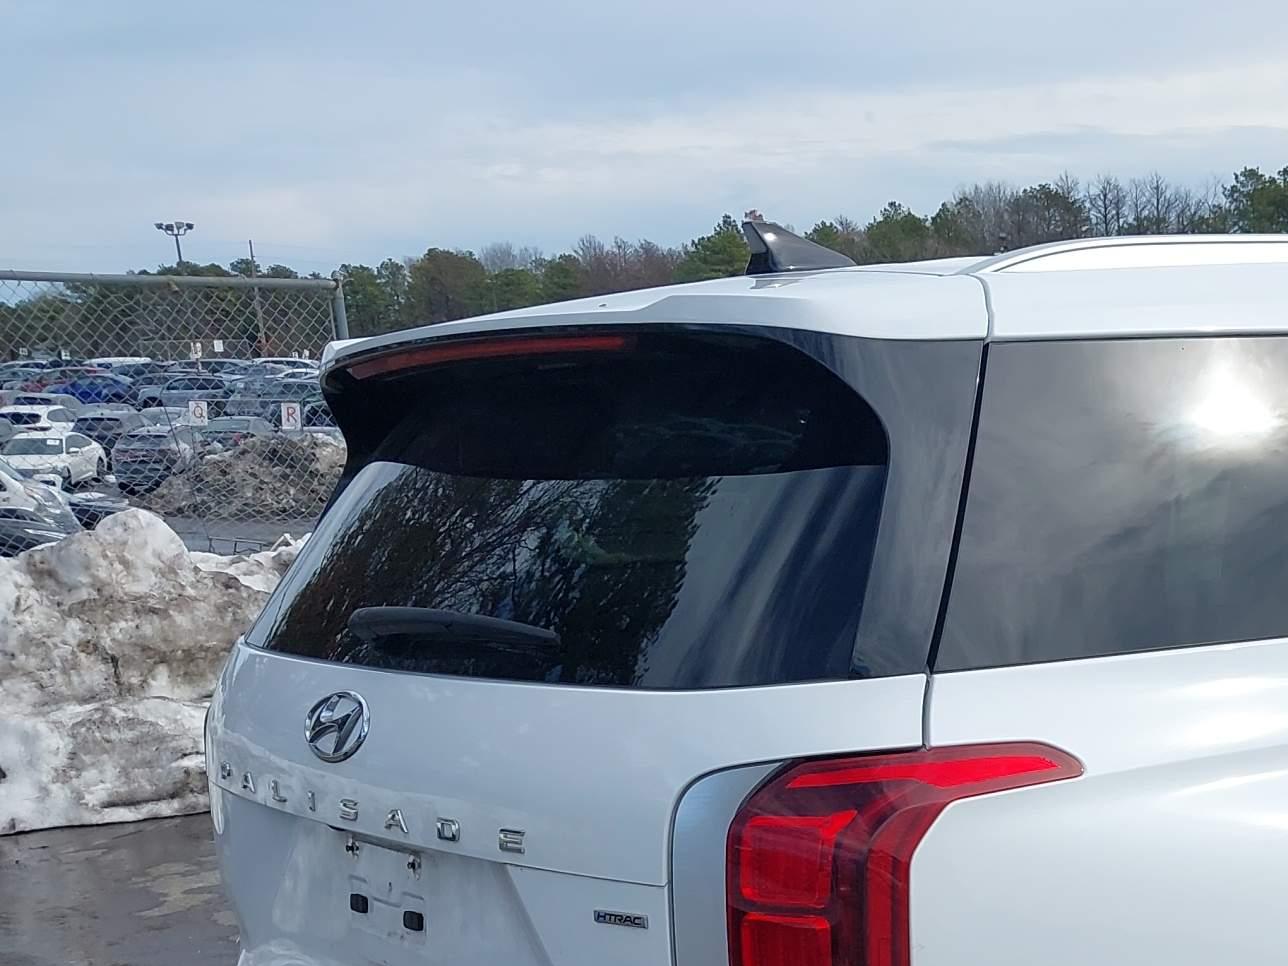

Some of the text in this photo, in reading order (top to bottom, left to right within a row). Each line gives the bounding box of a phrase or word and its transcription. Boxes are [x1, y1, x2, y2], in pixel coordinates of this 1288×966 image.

[286, 406, 297, 423] R
[221, 760, 526, 854] PALISADE
[596, 911, 643, 926] HTRAC
